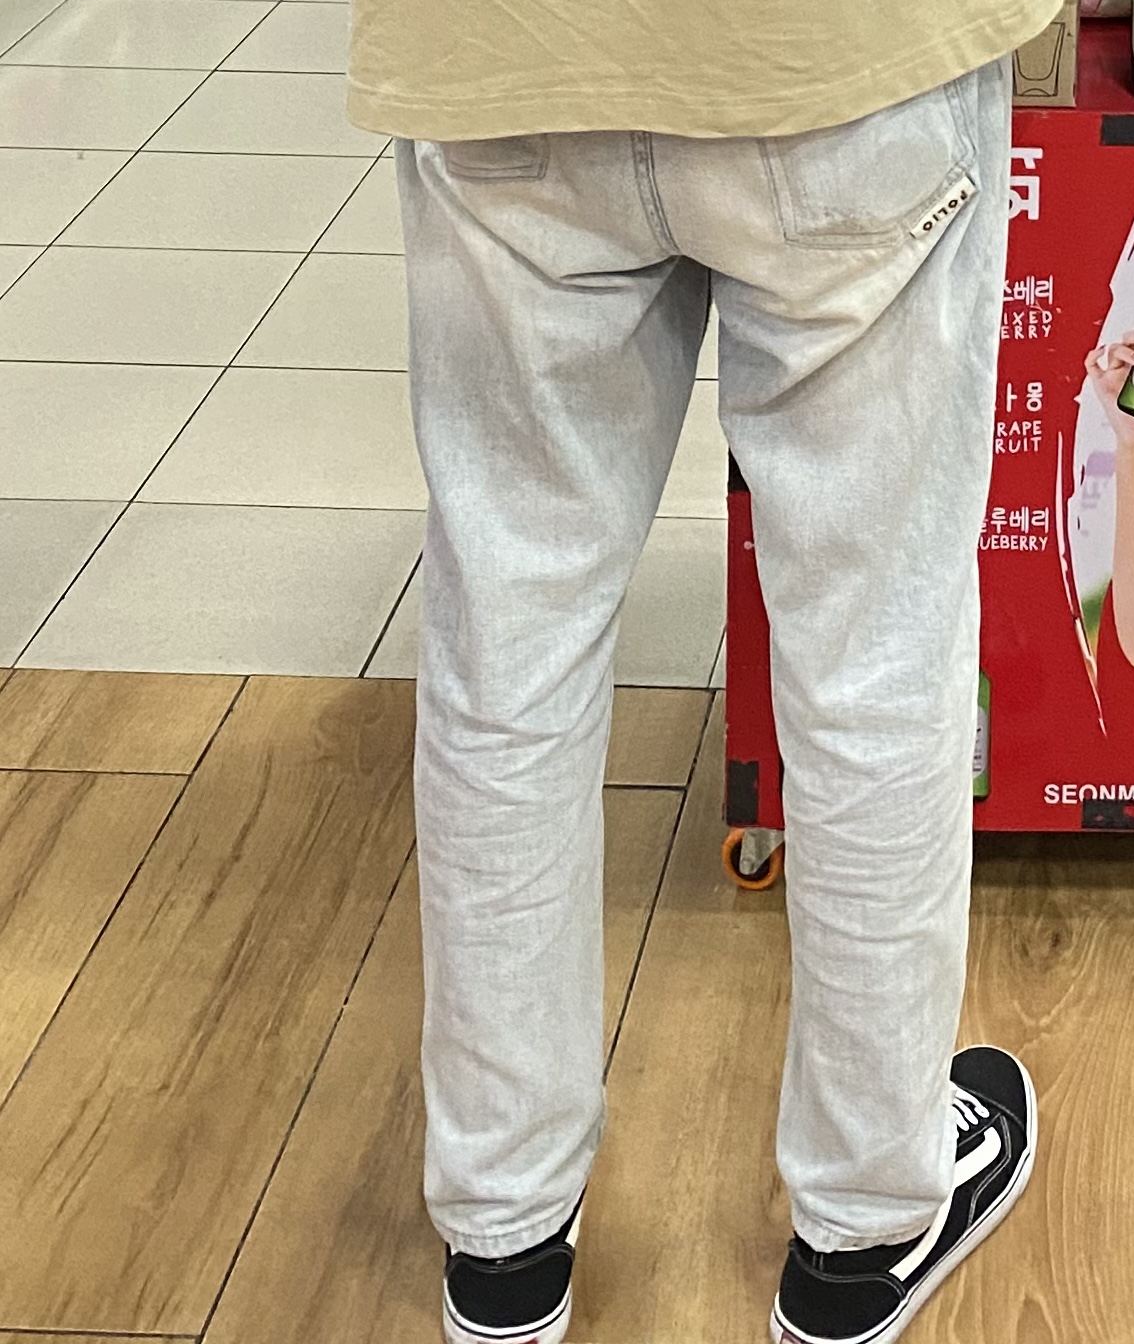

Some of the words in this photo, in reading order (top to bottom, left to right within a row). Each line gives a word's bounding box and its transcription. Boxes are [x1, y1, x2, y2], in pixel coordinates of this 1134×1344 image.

[1003, 311, 1053, 326] IXED
[1001, 324, 1052, 340] ERRY
[996, 420, 1042, 437] RAPE
[995, 437, 1042, 454] RUIT
[979, 535, 1048, 551] UEBERRY
